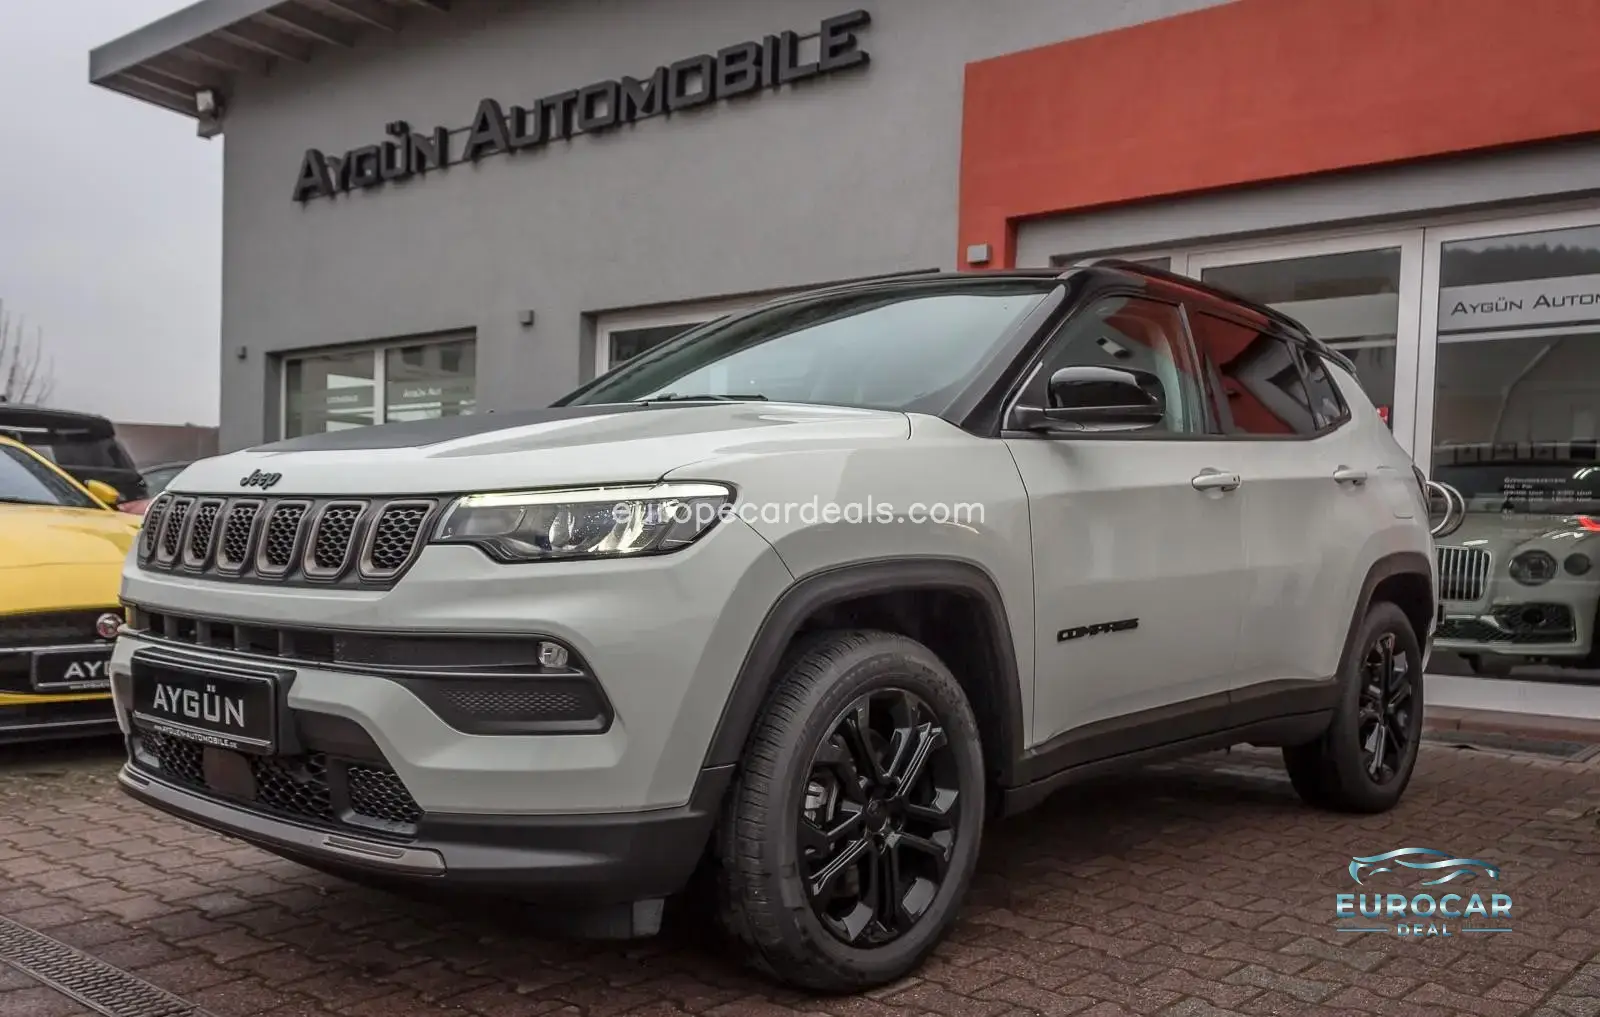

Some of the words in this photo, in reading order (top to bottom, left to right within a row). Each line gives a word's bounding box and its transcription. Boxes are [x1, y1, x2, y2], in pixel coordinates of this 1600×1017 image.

[293, 120, 448, 201] AYGÜN
[463, 10, 871, 161] AUTOMOBILE
[1451, 296, 1523, 316] AYGÜN
[240, 469, 282, 490] Jeep
[153, 683, 245, 728] AYGÜN
